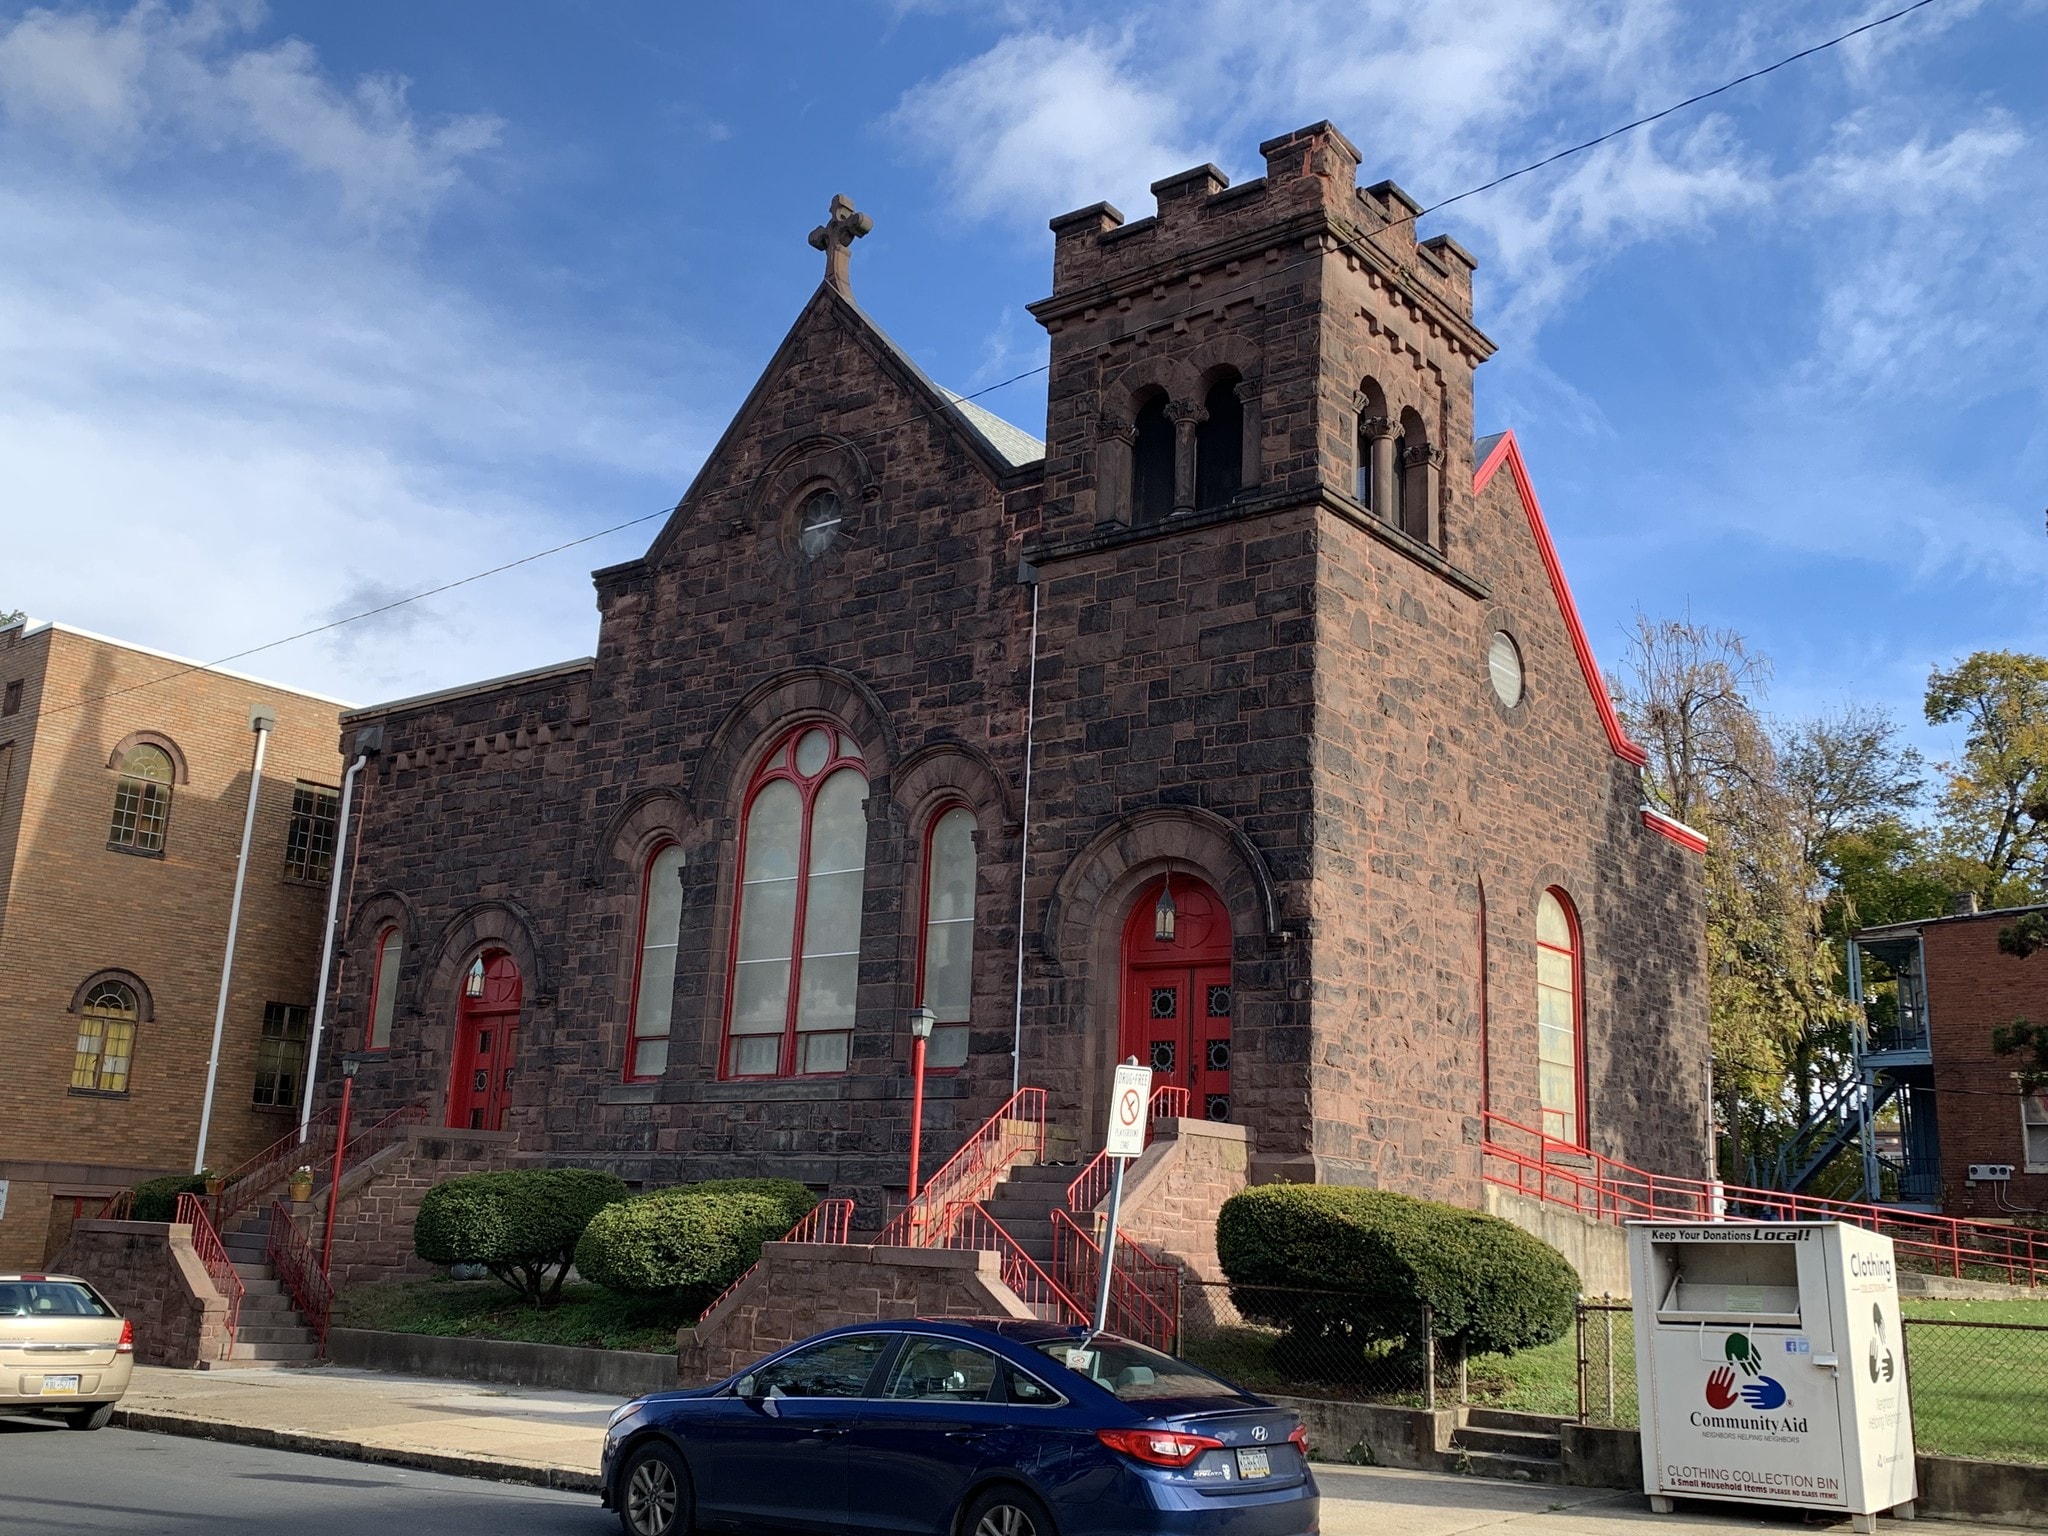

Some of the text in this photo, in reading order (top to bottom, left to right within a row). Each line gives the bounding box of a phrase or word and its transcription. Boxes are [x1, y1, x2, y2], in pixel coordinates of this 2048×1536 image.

[1118, 1072, 1148, 1086] DRUG-FREE
[1651, 1229, 1811, 1241] Keep Your Donations Local!
[1850, 1252, 1892, 1282] Clothing
[1702, 1431, 1800, 1443] NEIGHBORS HELPING NEIGHBORS
[1667, 1465, 1839, 1490] CLOTHING COLLECTION BIN
[1677, 1479, 1699, 1488] Small
[1701, 1482, 1742, 1491] Household
[1744, 1485, 1767, 1494] Items
[1792, 1489, 1800, 1497] NO
[1801, 1490, 1818, 1498] GLASS
